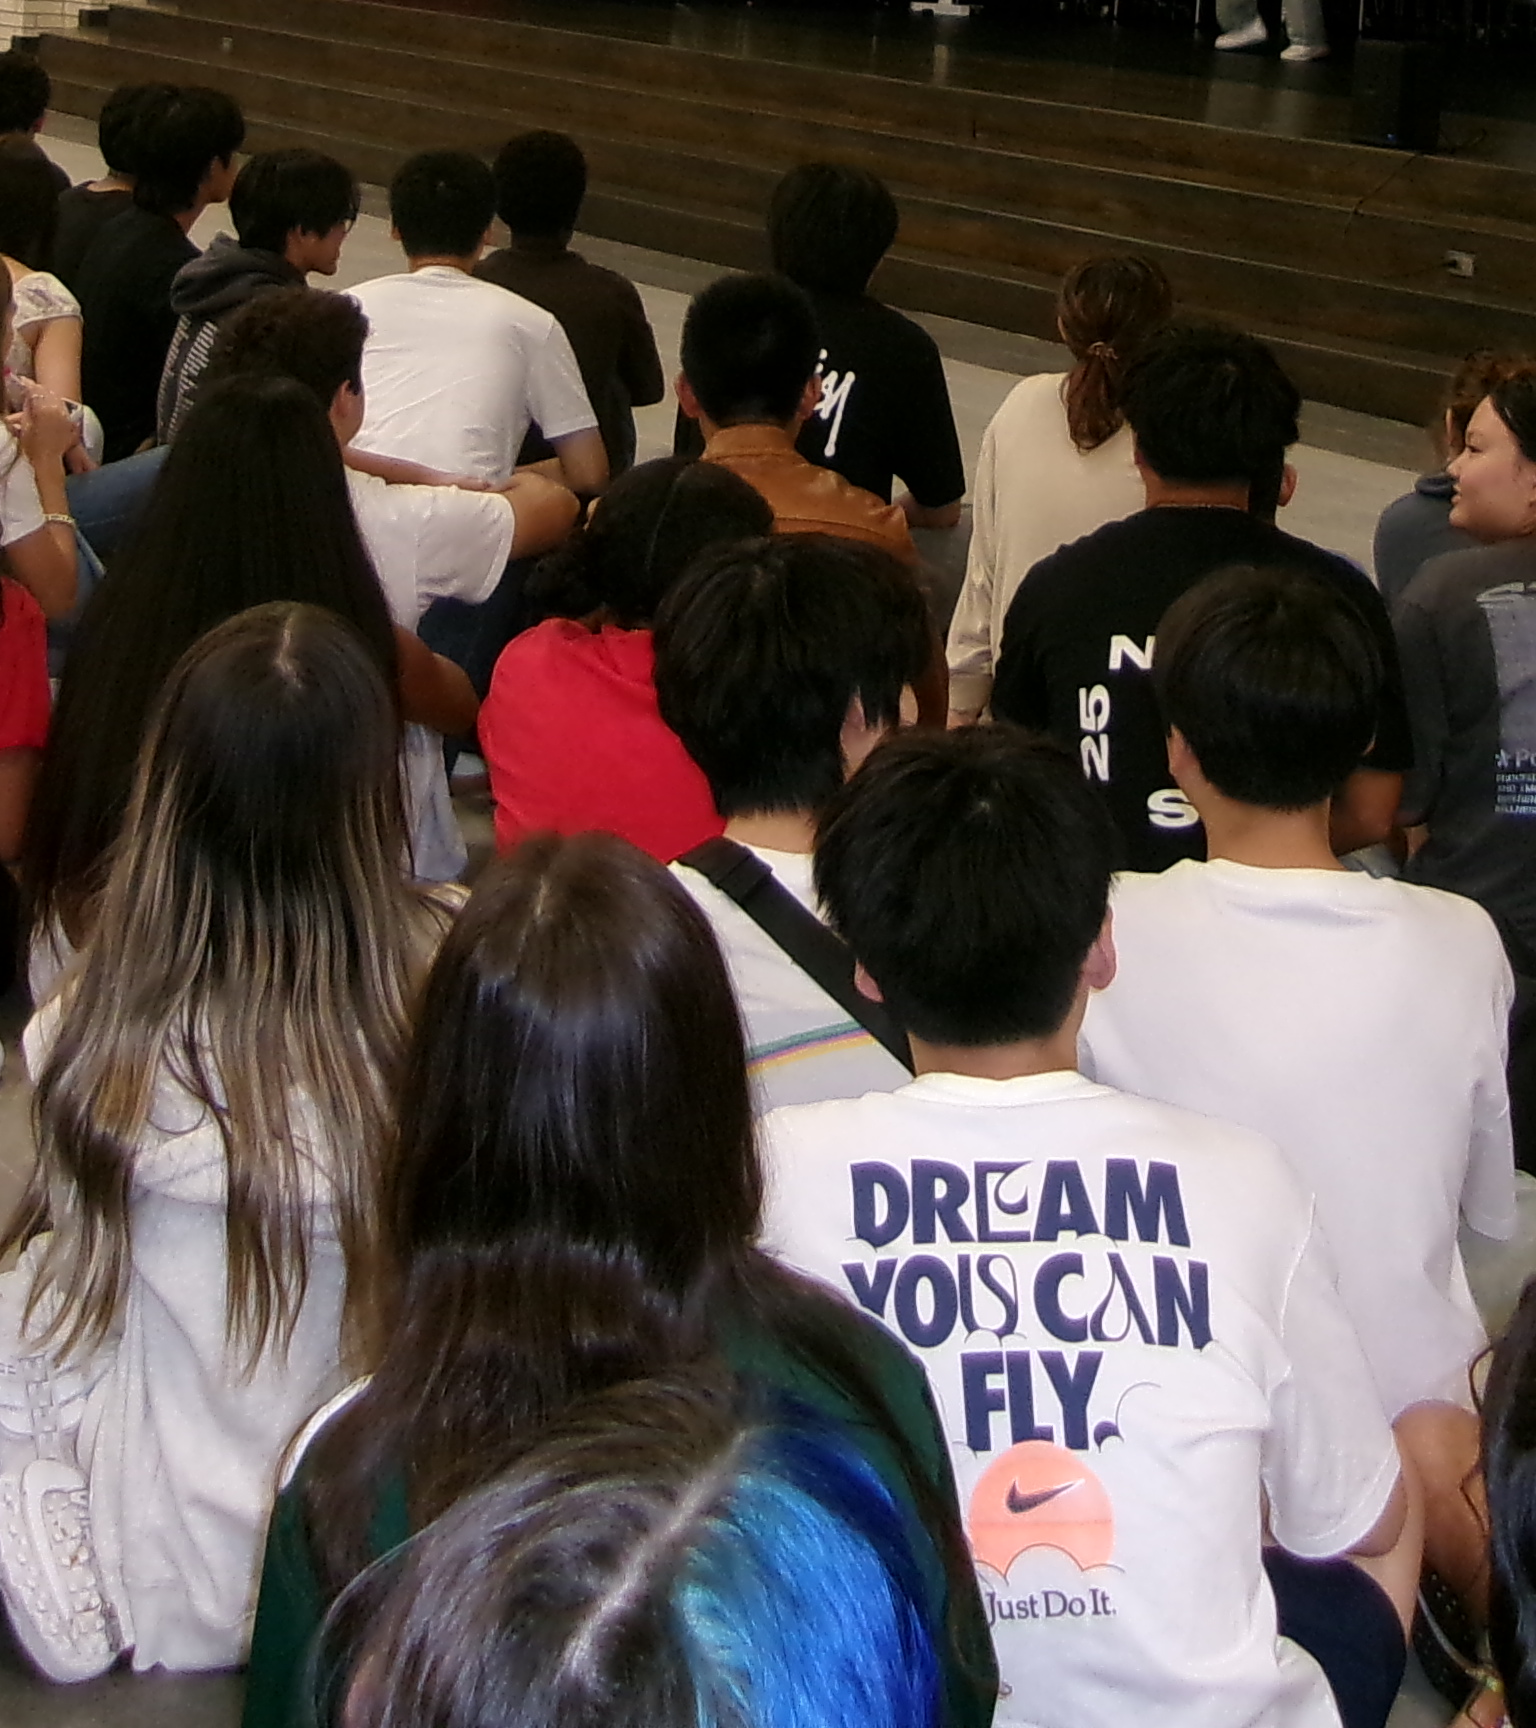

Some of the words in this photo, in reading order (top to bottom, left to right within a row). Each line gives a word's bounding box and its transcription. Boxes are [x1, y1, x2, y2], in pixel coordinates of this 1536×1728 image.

[849, 1155, 1191, 1248] DREAM
[841, 1253, 1019, 1348] YOU
[1034, 1251, 1213, 1351] CAN
[987, 1590, 1040, 1625] Just
[1044, 1590, 1086, 1618] Do
[1090, 1588, 1117, 1617] It.
